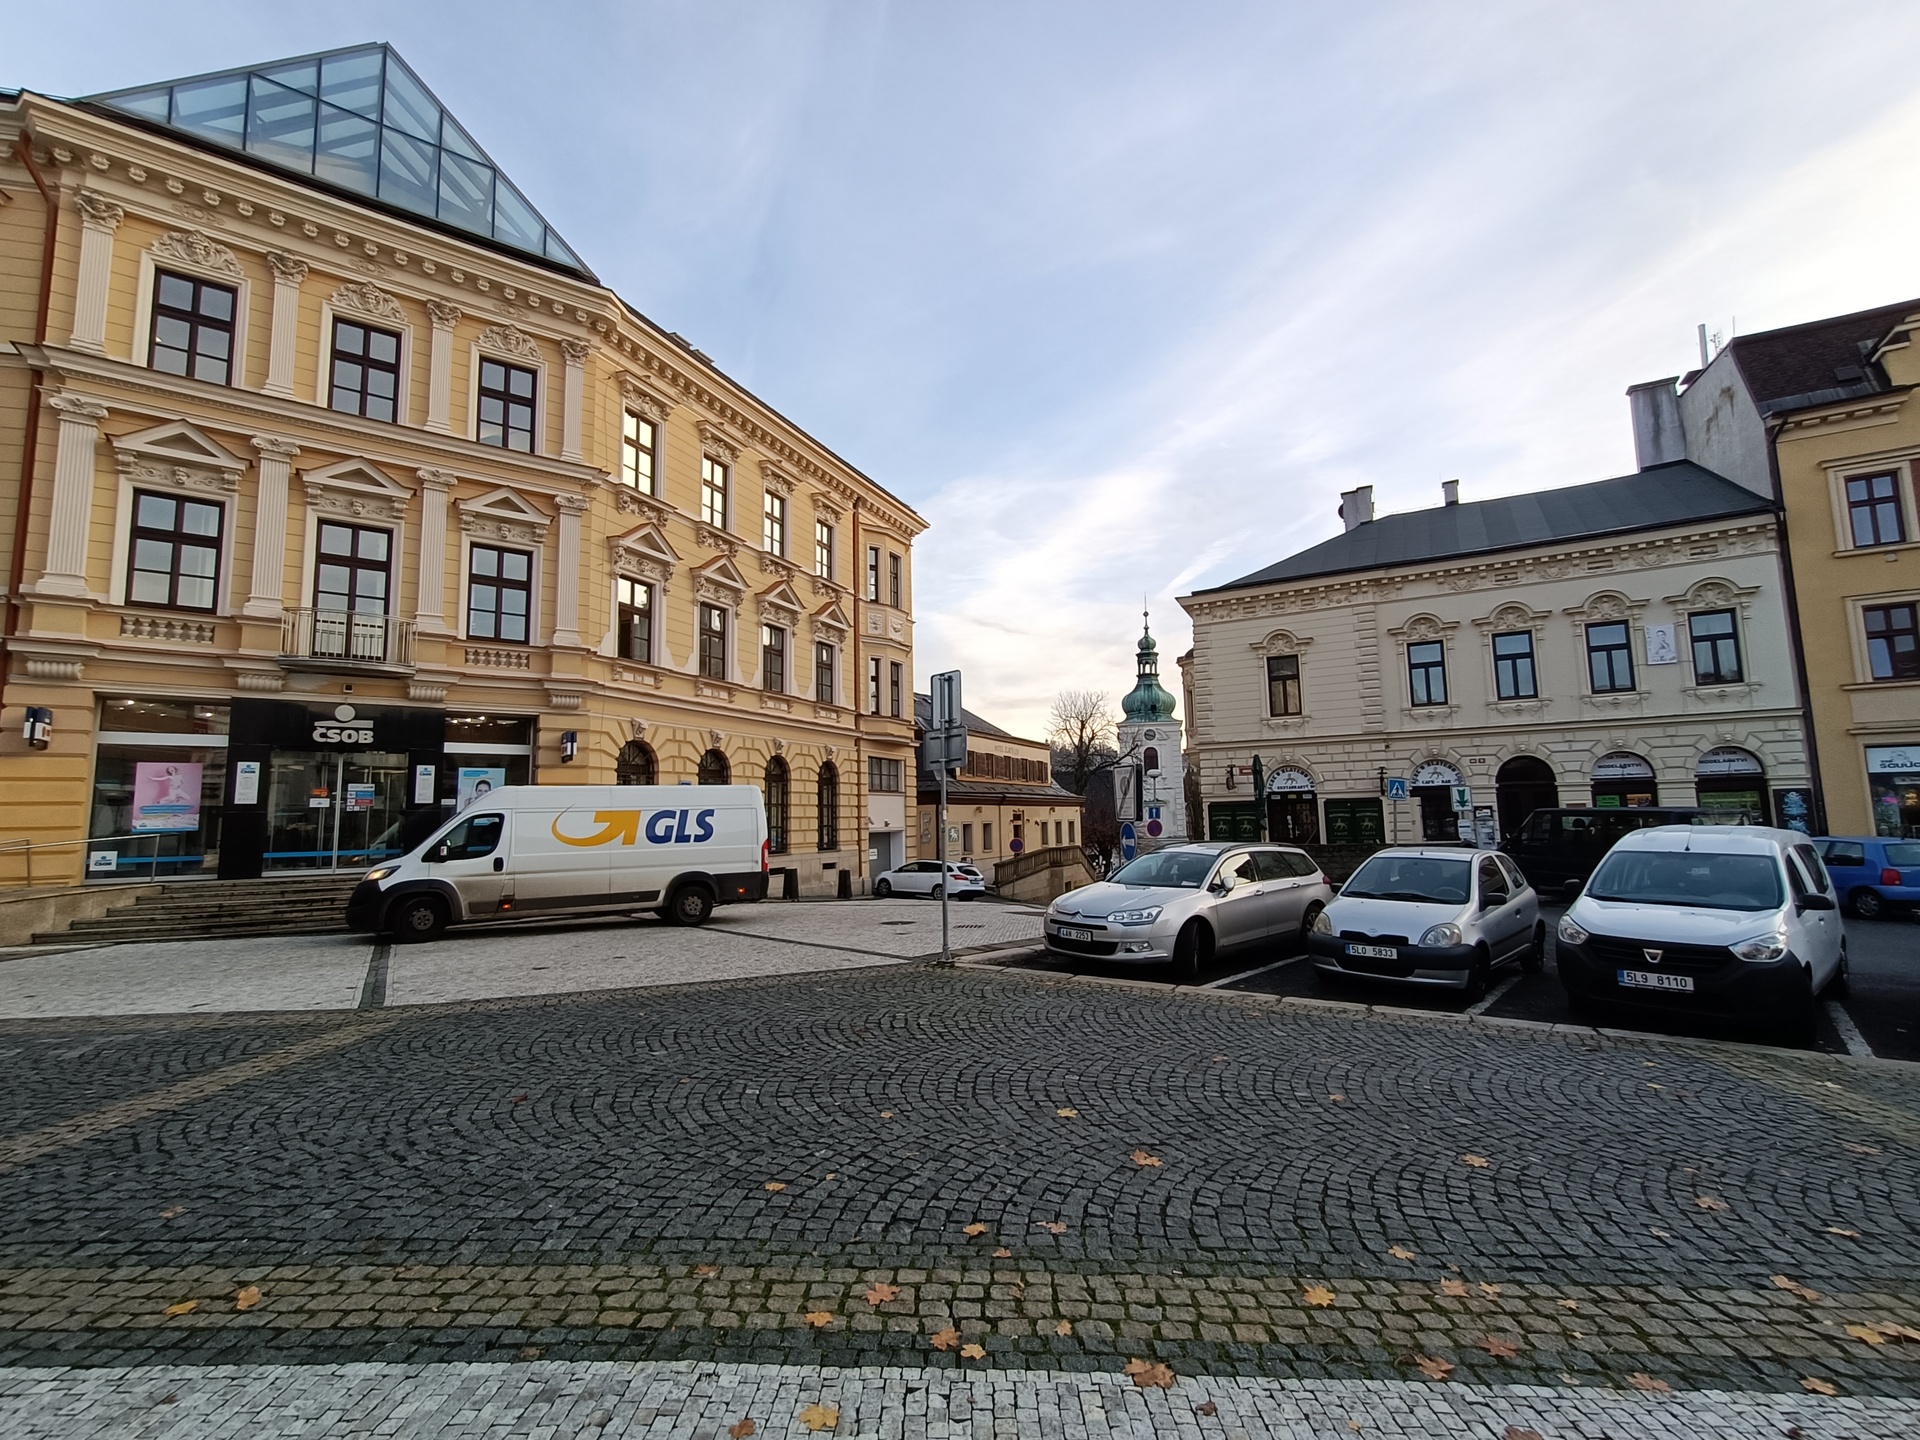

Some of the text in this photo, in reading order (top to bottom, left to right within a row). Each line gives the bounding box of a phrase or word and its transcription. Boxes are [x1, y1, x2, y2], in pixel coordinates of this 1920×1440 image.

[312, 726, 374, 744] ČSOB
[645, 809, 715, 844] GLS
[1372, 947, 1393, 957] 5833
[1626, 971, 1687, 988] 5L9 8110
